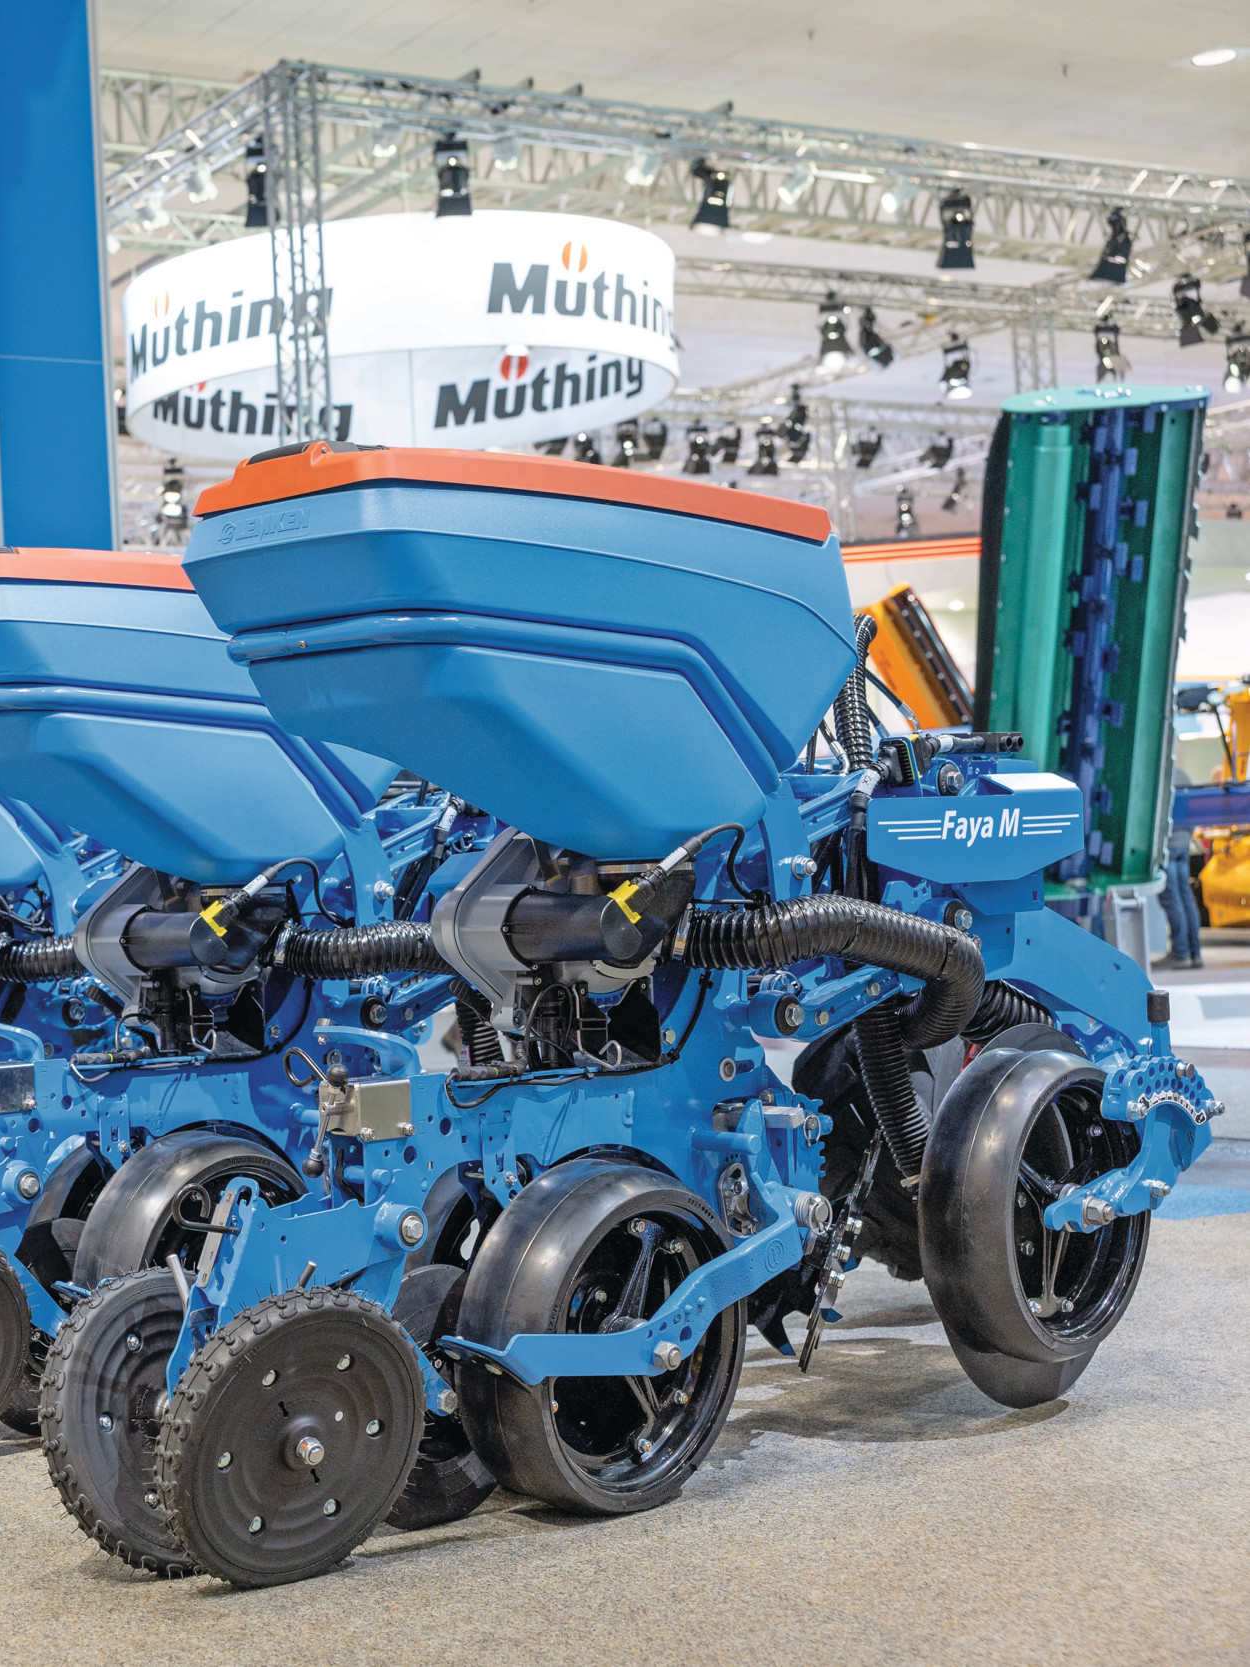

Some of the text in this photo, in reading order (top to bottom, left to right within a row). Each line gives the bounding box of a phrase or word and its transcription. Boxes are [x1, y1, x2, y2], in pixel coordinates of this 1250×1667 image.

[235, 508, 310, 541] LEMKEN
[941, 808, 1020, 847] Faya M
